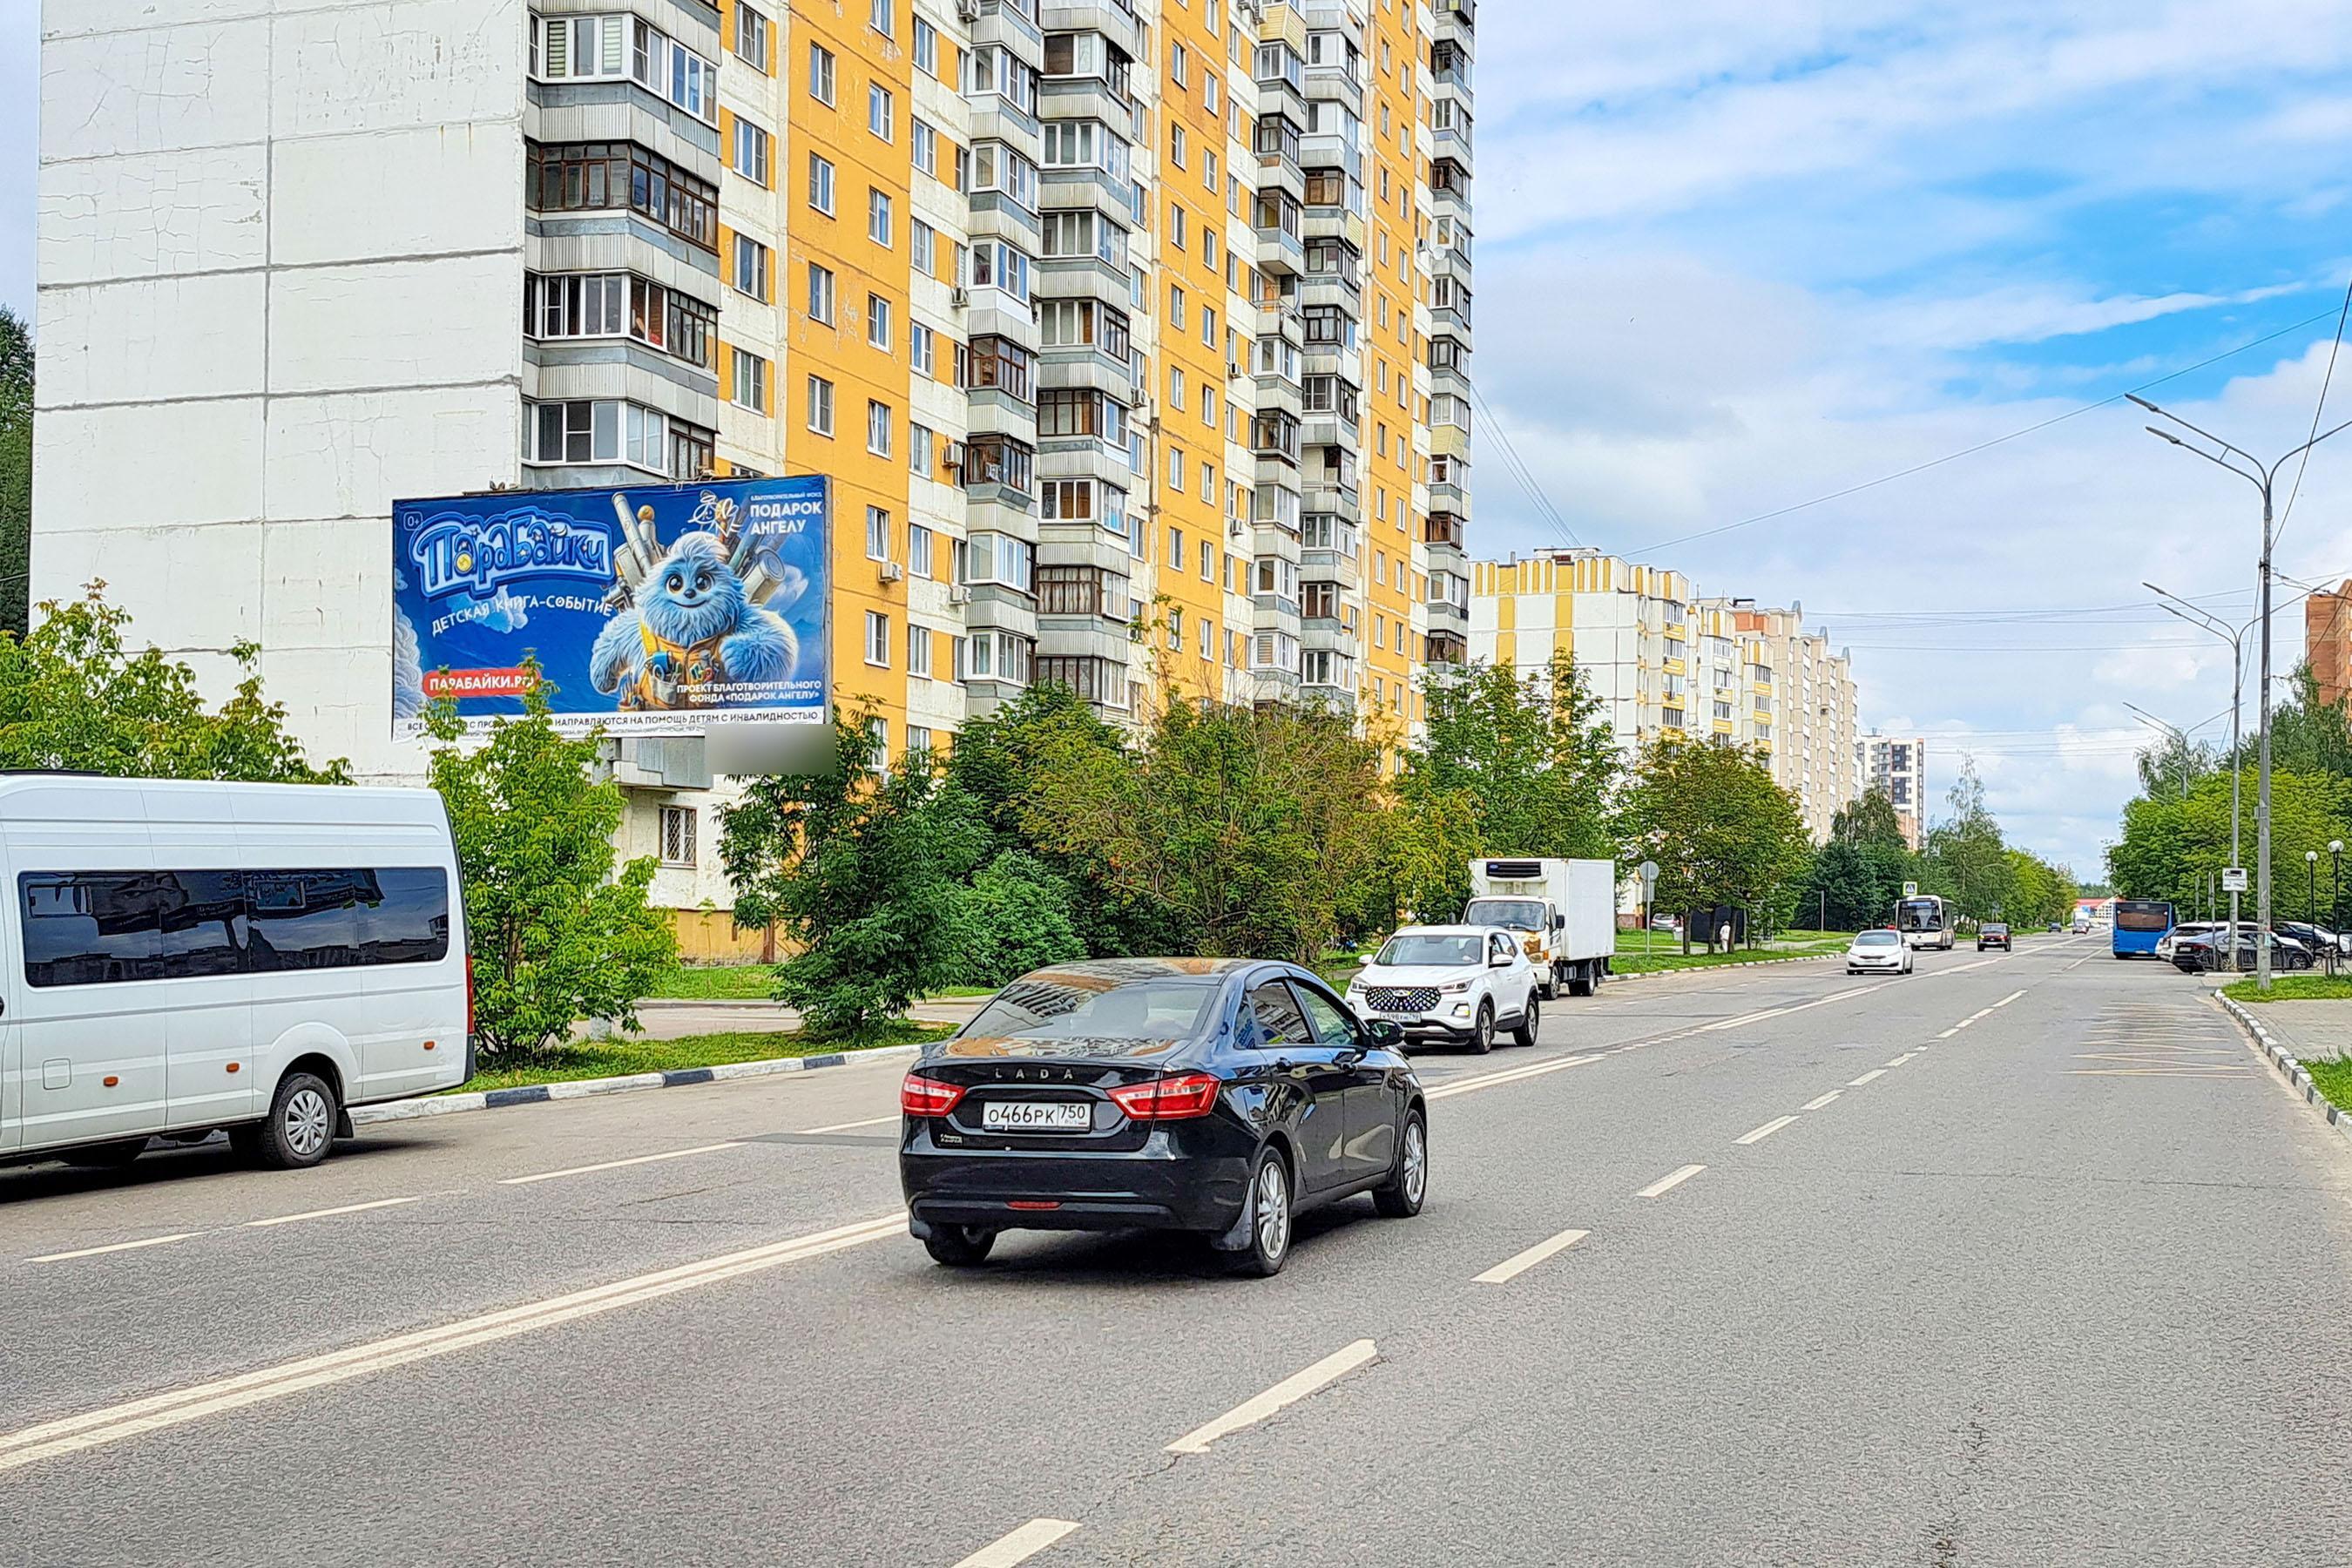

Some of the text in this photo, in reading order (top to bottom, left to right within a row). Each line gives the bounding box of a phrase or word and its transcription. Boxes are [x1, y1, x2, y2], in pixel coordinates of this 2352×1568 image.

[750, 501, 823, 517] ПОДАРОК
[407, 516, 421, 527] 0+
[750, 519, 807, 535] АНГЕЛУ
[431, 594, 613, 638] ДЕТСКАЯ КНИГА-СОБЫТИЕ
[677, 679, 822, 693] ПРОЕКТ БЛАГОТВОРИТЕЛЬНОГО
[689, 690, 820, 704] ФОНДА «ПОДАРОК АНГЕЛУ»
[407, 722, 423, 731] ВСЕ
[555, 716, 628, 727] НАПРАВЛЯЮТСЯ
[630, 716, 643, 725] НА
[645, 714, 687, 725] ПОМОЩЬ
[688, 714, 719, 725] ДЕТЯМ
[720, 713, 729, 722] С
[730, 711, 818, 722] ИНВАЛИДНОСТЬЮ
[995, 1068, 1073, 1079] LADA
[1059, 1105, 1086, 1119] 750
